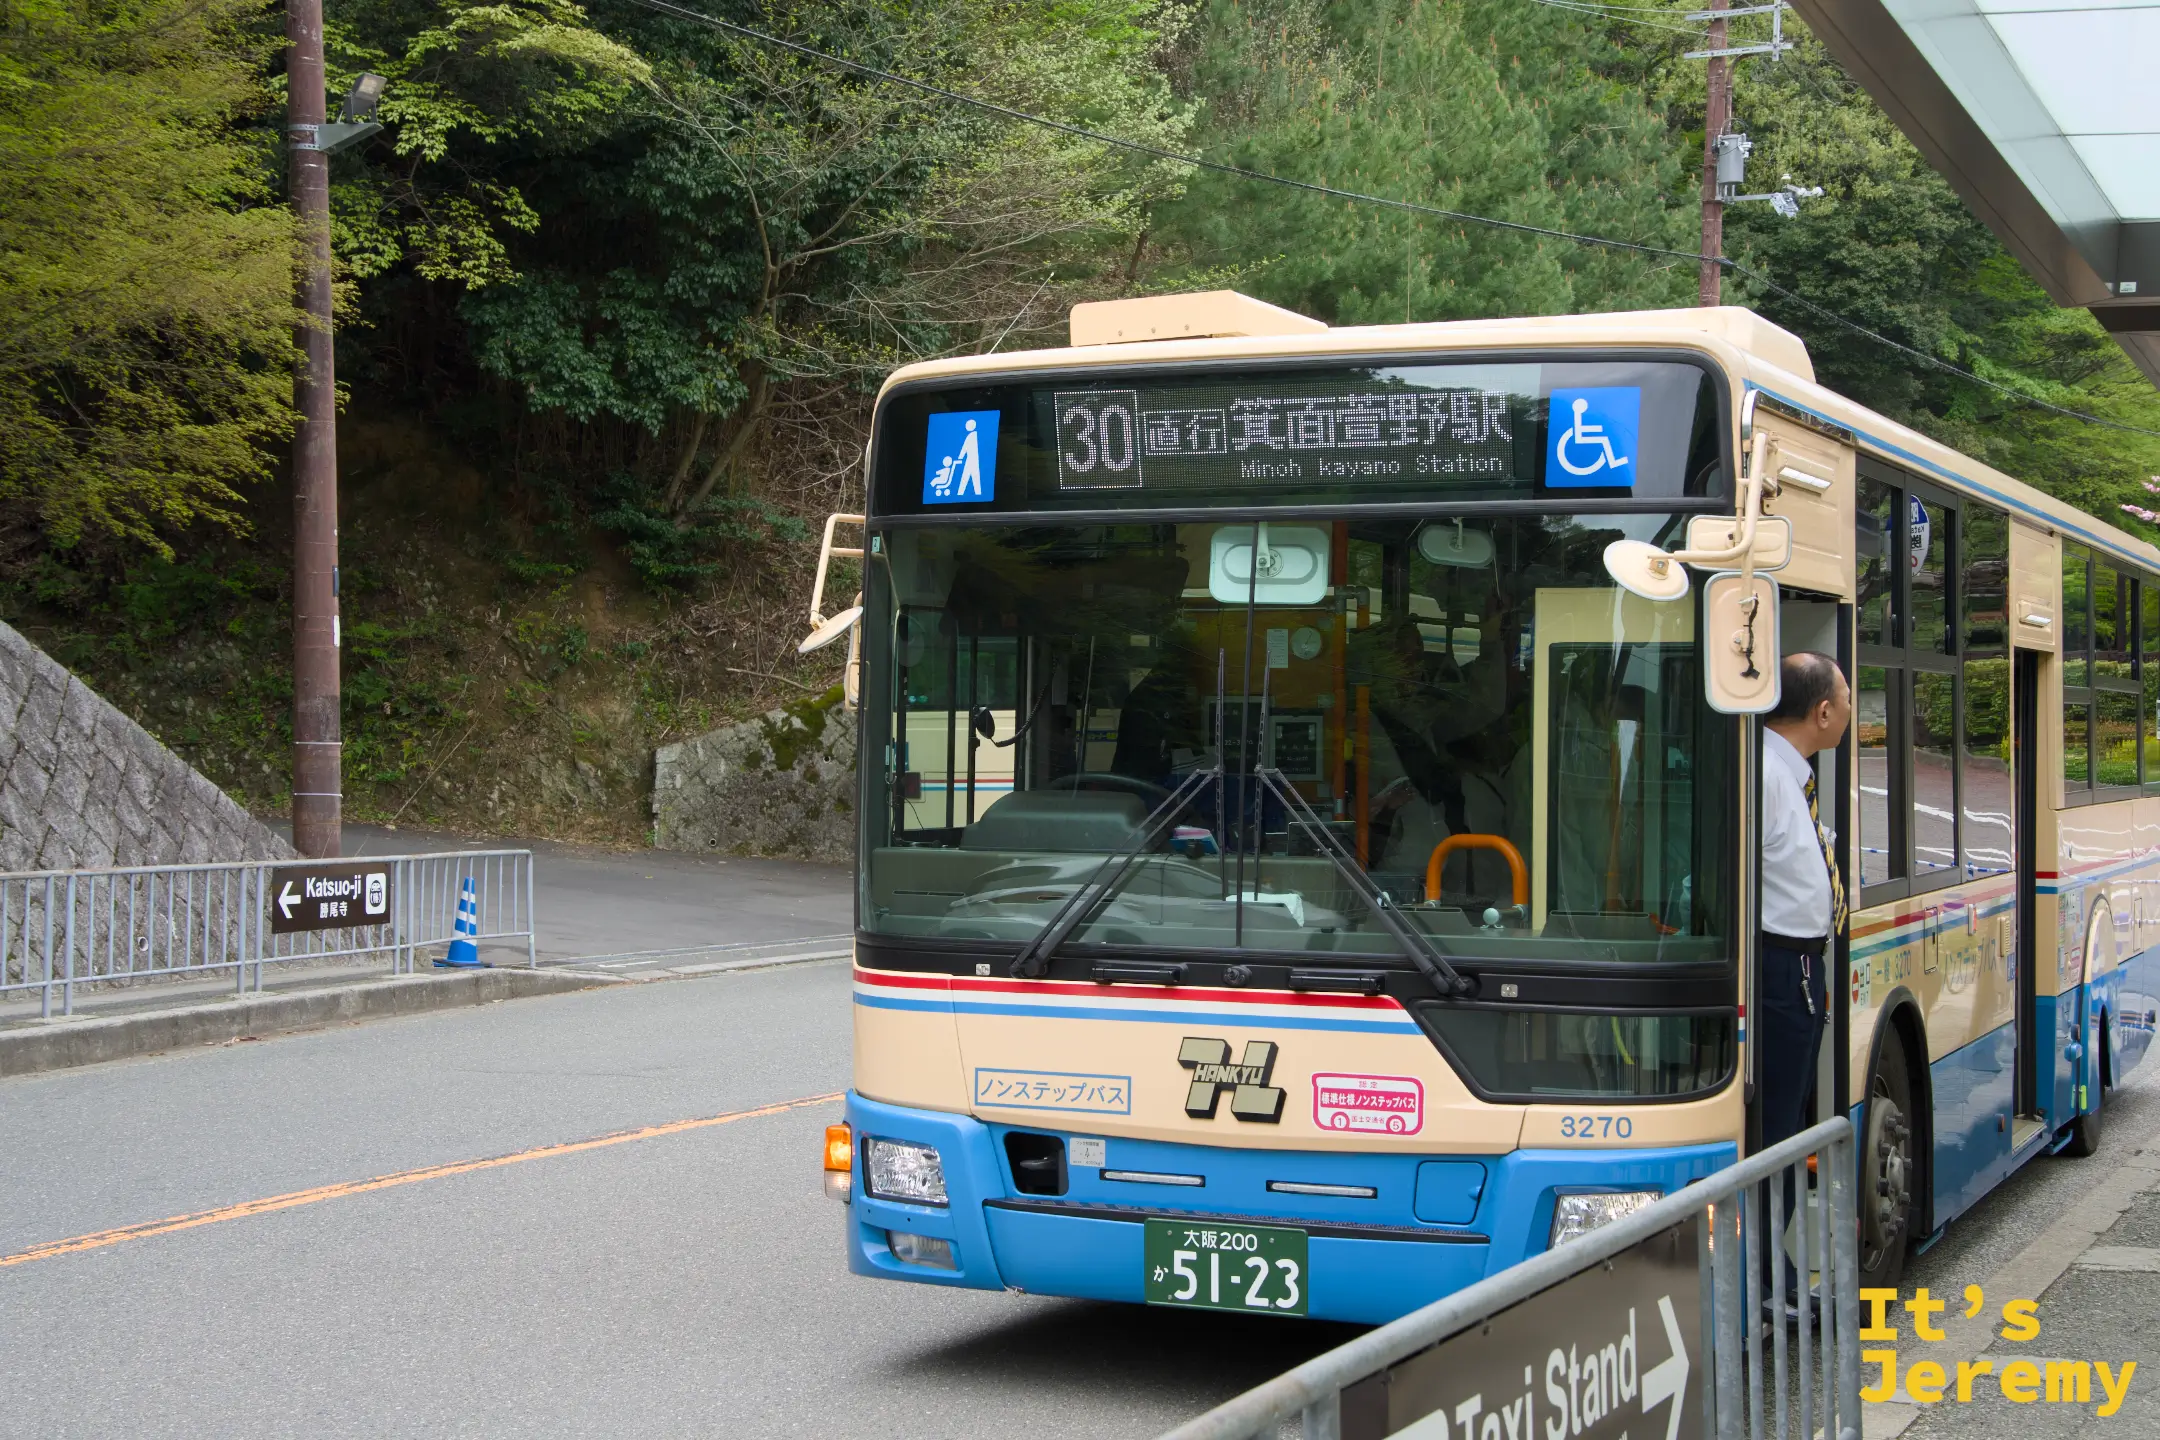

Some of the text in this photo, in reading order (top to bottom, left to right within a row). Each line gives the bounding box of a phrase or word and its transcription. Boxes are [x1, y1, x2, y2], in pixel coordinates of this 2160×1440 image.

[1063, 404, 1133, 472] 30
[1148, 415, 1221, 450] 直行
[1241, 458, 1301, 478] Minoh
[1416, 453, 1502, 474] Station
[306, 874, 361, 900] Katsuo-ji
[320, 901, 348, 919] 勝尾寺
[1195, 1063, 1264, 1085] HANKYU
[980, 1078, 1125, 1105] ノンステップバス
[1561, 1115, 1632, 1138] 3270
[1173, 1250, 1300, 1309] 51-23
[1545, 1307, 1637, 1440] Stand
